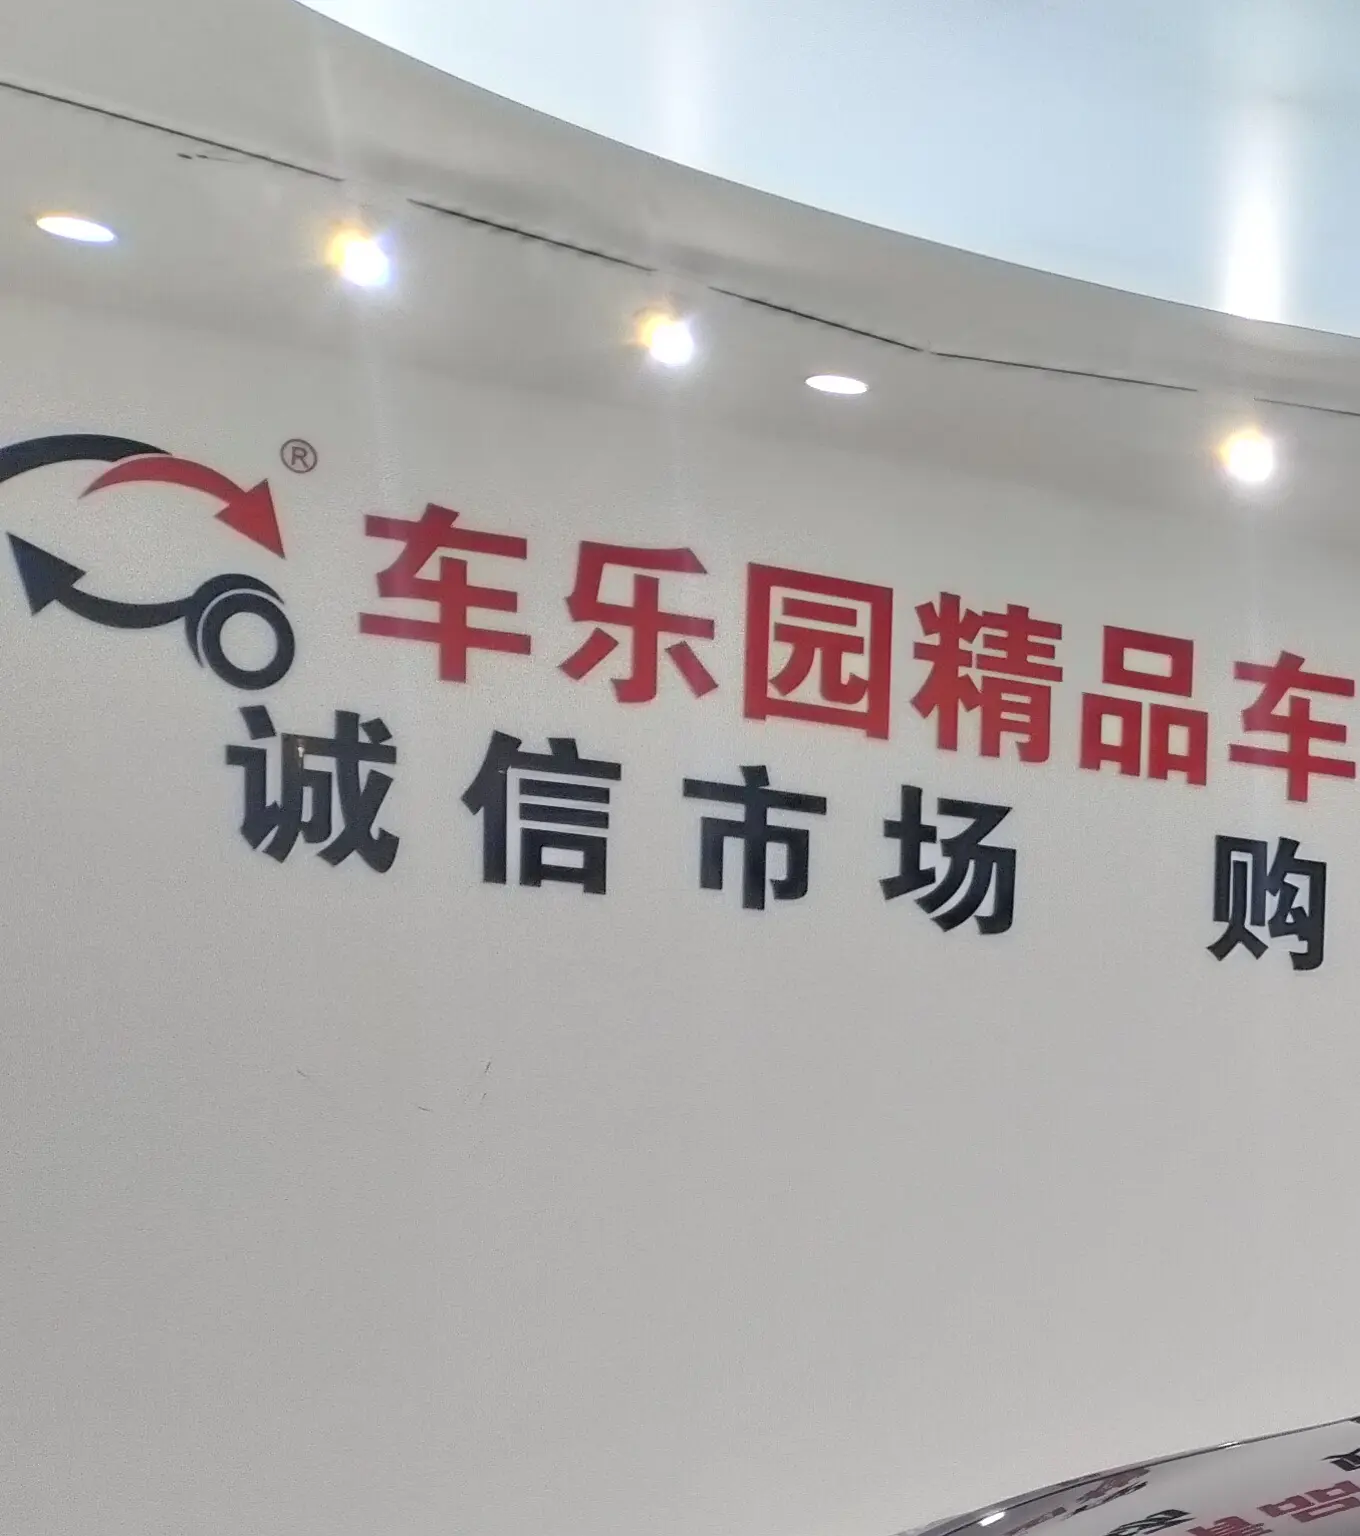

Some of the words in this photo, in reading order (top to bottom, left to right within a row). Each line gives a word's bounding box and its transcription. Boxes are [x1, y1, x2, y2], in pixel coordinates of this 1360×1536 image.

[359, 503, 1356, 802] 车乐园精品车
[225, 705, 1017, 935] 诚信市场
